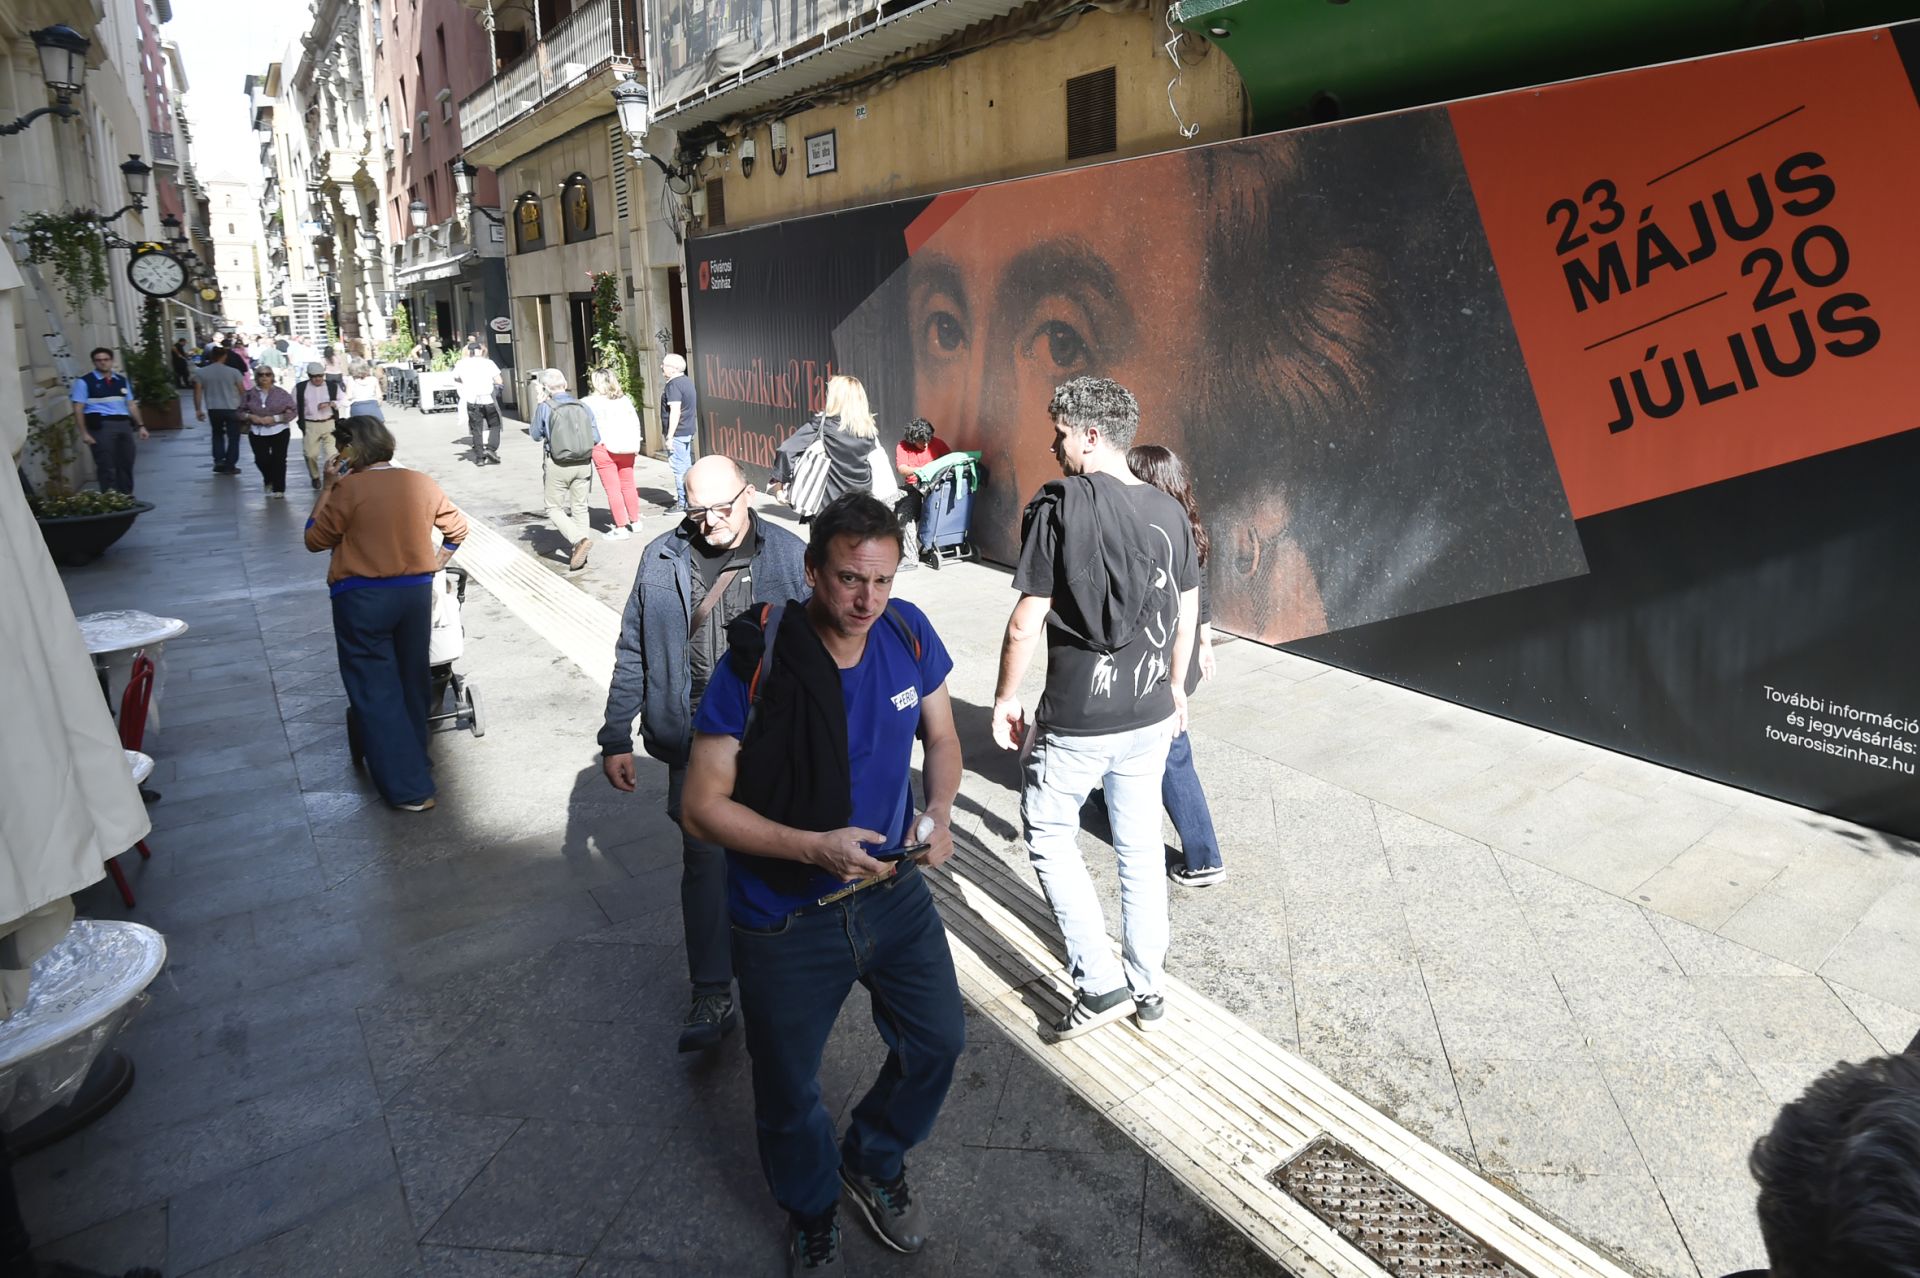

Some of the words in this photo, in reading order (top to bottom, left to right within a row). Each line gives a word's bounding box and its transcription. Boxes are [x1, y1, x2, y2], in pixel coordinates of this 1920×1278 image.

[1546, 178, 1626, 257] 23
[1562, 151, 1836, 313] MÁJUS
[1740, 224, 1850, 313] 20
[705, 353, 800, 409] Klasszikus?
[1607, 292, 1881, 435] JÚLIUS
[1763, 685, 1825, 713] További
[1828, 701, 1920, 734] információ
[1786, 711, 1805, 728] és
[1806, 715, 1918, 755] jegyvásárlás:
[1764, 725, 1915, 775] fovarosiszinhaz.hu
